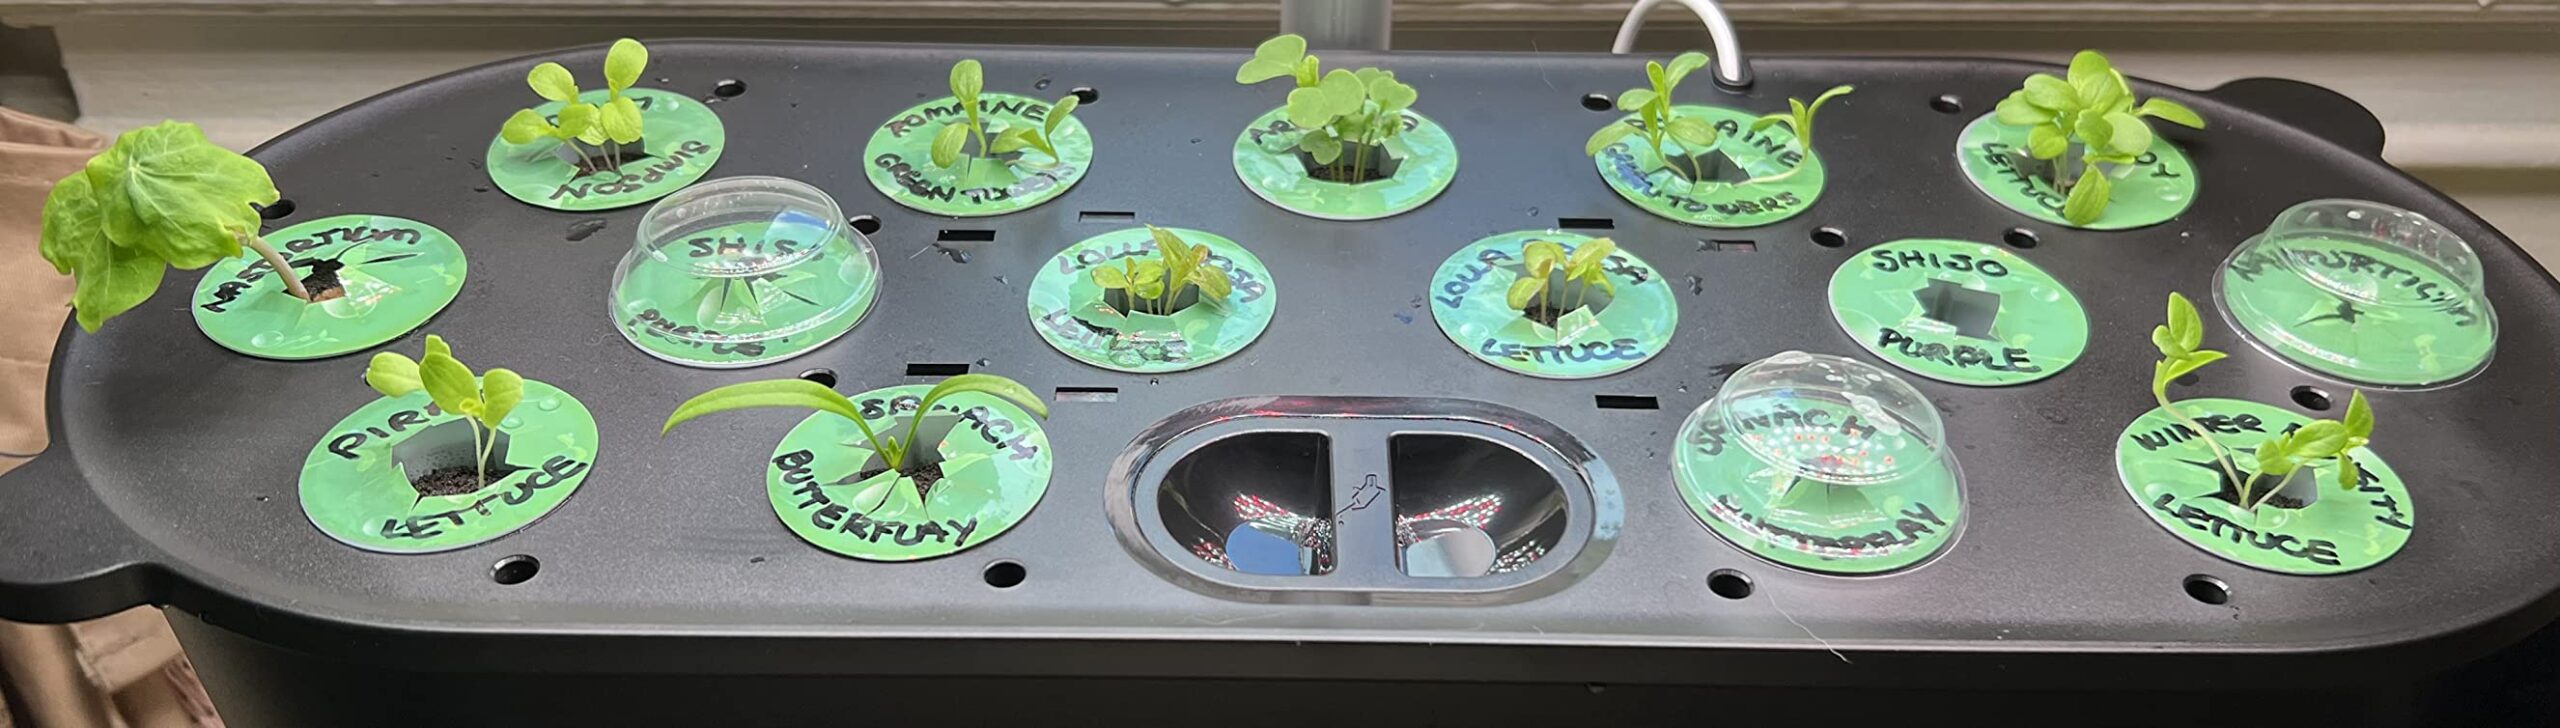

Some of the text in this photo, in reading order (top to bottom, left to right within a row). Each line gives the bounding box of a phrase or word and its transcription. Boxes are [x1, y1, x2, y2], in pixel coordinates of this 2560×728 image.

[1480, 338, 1647, 364] LETTUCE
[380, 455, 589, 540] LETTUCE
[2153, 493, 2342, 567] LETTUCE
